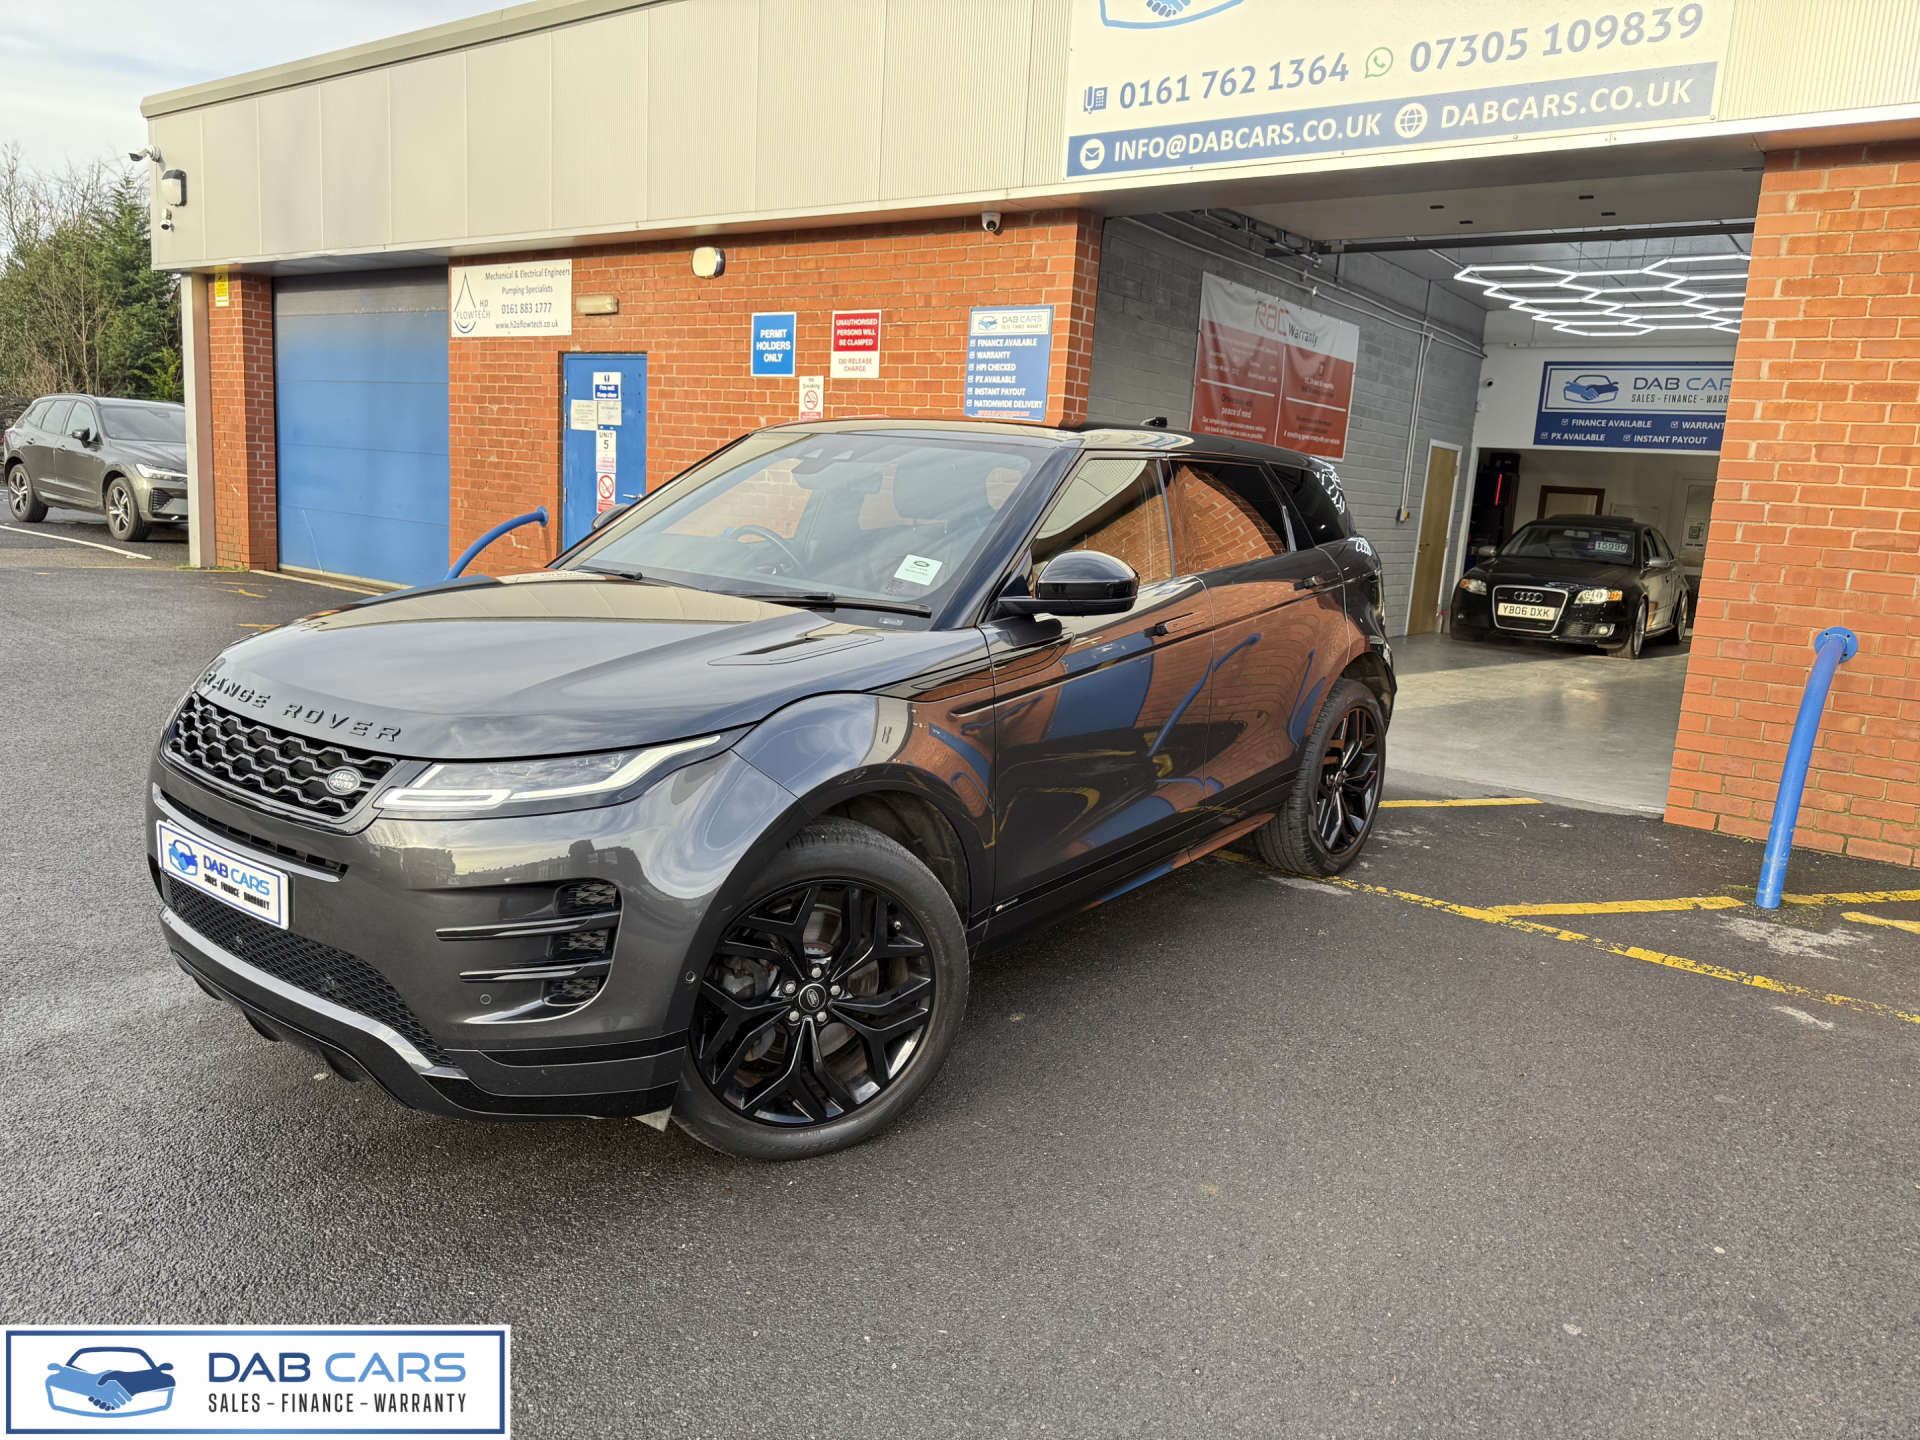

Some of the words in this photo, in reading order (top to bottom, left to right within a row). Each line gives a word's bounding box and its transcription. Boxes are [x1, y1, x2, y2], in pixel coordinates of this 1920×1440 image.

[1409, 27, 1529, 73] 07305
[1541, 2, 1704, 58] 109839
[1119, 73, 1191, 110] 0161
[1201, 65, 1256, 100] 762
[1267, 52, 1350, 91] 1364
[1440, 77, 1693, 129] DABCARS.CO.UK
[1113, 112, 1382, 163] INFO@DABCARS.CO.UK
[502, 304, 518, 315] 0161
[535, 302, 552, 313] 1777
[456, 310, 490, 320] FLOWTECH
[760, 329, 788, 338] PERMIT
[1288, 322, 1319, 347] Warranty
[756, 341, 791, 350] HOLDERS
[977, 339, 1003, 348] FINANCE
[1004, 338, 1038, 346] AVAILABLE
[763, 354, 783, 362] ONLY
[976, 351, 1011, 360] WARRANTY
[985, 376, 1016, 384] AVAILABLE
[1633, 377, 1680, 390] DAB
[1632, 394, 1656, 403] SALES
[1664, 394, 1697, 404] FINANCE
[1014, 400, 1043, 409] DELIVERY
[1572, 418, 1606, 428] FINANCE
[1608, 420, 1652, 428] AVAILABLE
[1551, 432, 1562, 440] PX
[1562, 432, 1606, 441] AVAILABLE
[1634, 434, 1671, 443] INSTANT
[1672, 436, 1708, 445] PAYOUT
[603, 440, 609, 450] 5
[1503, 604, 1528, 616] YB06
[1530, 607, 1550, 617] DXK
[200, 670, 271, 710] RANGE
[282, 702, 402, 743] ROVER
[203, 854, 229, 878] DAB
[230, 868, 270, 896] CARS
